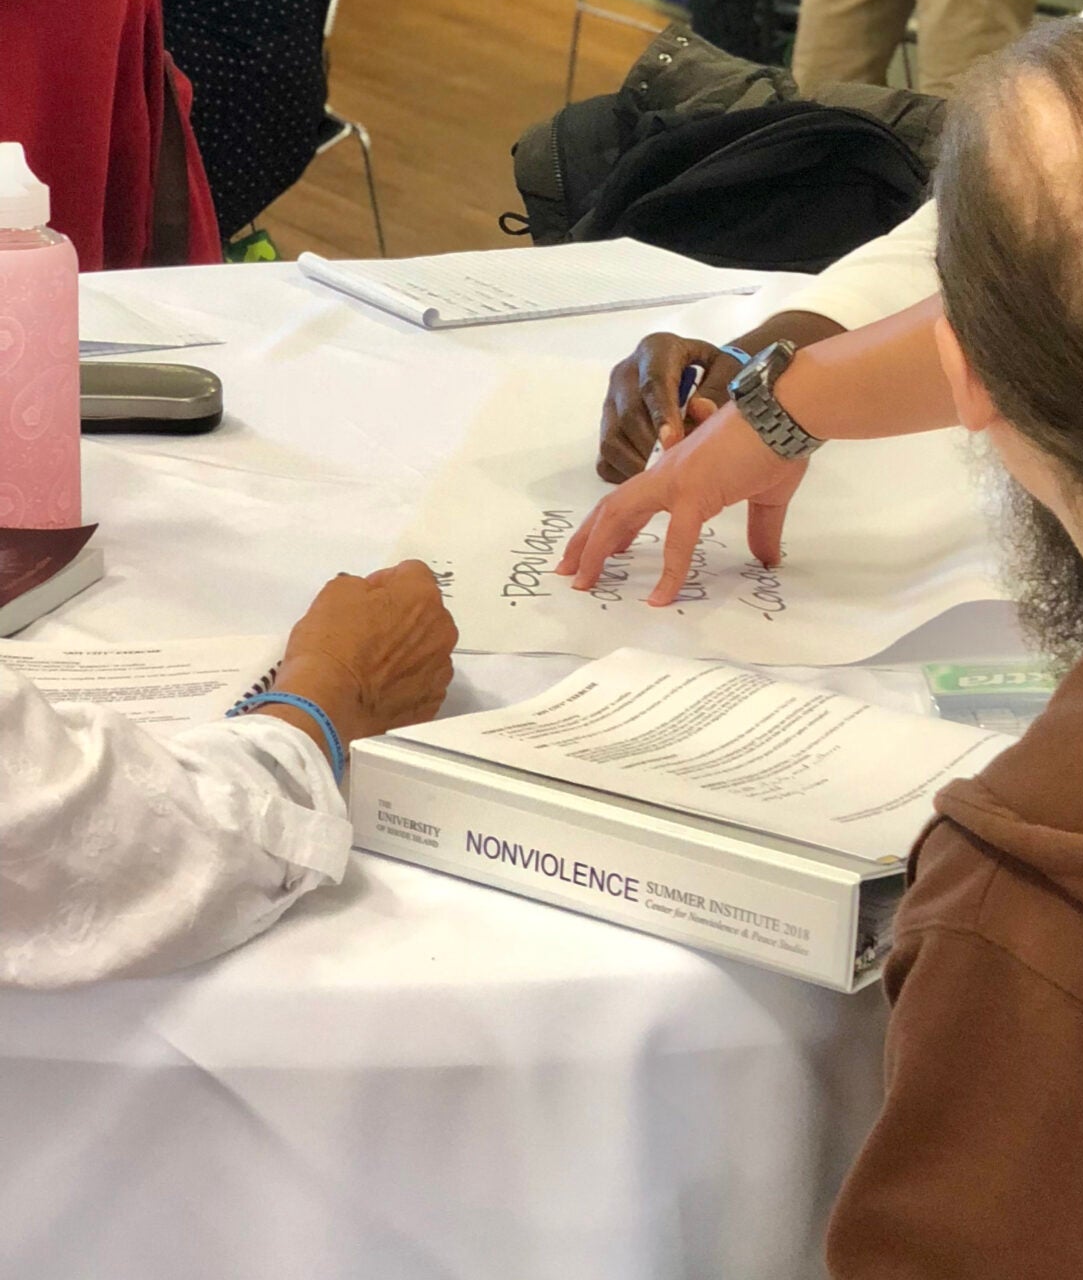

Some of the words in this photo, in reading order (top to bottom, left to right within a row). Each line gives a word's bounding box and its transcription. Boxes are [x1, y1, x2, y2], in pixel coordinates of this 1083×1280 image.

[378, 810, 441, 838] UNIVERSITY
[466, 830, 640, 903] NONVIOLENCE
[644, 899, 673, 915] Center
[673, 906, 687, 919] for
[687, 910, 740, 935] Nonviolence
[750, 930, 778, 948] Peace
[646, 880, 706, 910] SUMMER
[709, 899, 781, 933] INSTITUTE
[783, 922, 811, 941] 2018
